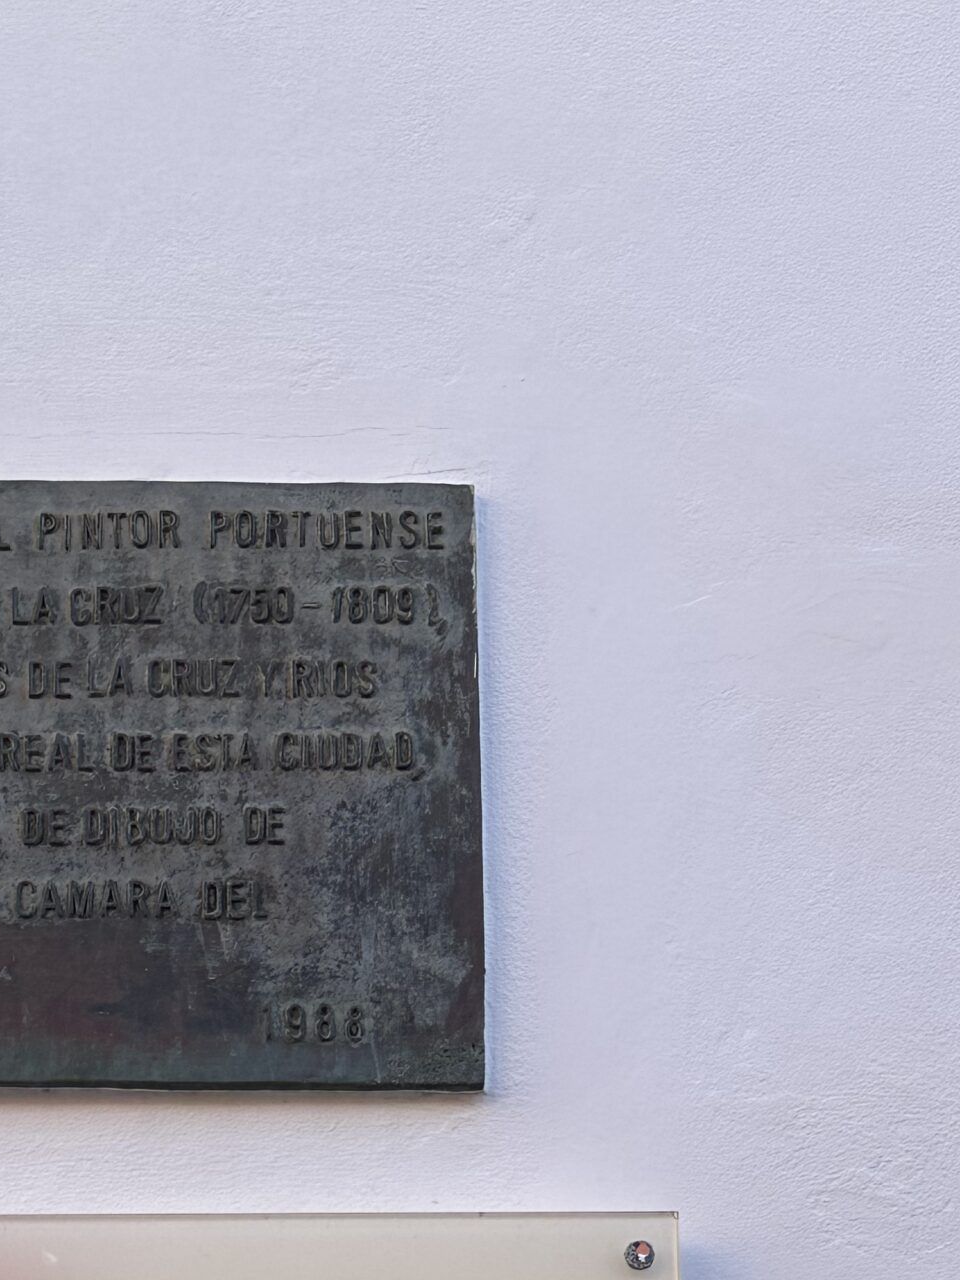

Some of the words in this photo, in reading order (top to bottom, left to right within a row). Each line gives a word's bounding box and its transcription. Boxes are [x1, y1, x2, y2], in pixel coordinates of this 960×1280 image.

[37, 510, 181, 552] PINTOR
[208, 510, 446, 551] PORTUENSE
[11, 586, 54, 626] LA
[69, 586, 165, 626] CRUZ
[28, 660, 73, 700] DE
[88, 660, 133, 699] LA
[146, 659, 240, 699] CRUZ
[257, 660, 278, 700] Y
[288, 658, 379, 699] RIOS
[110, 733, 155, 774] DE
[169, 734, 253, 773] ESTA
[21, 807, 69, 846] DE
[85, 806, 222, 847] DIBUJO
[244, 806, 286, 846] DE
[15, 880, 178, 920] CAMARA
[200, 880, 268, 920] DEL
